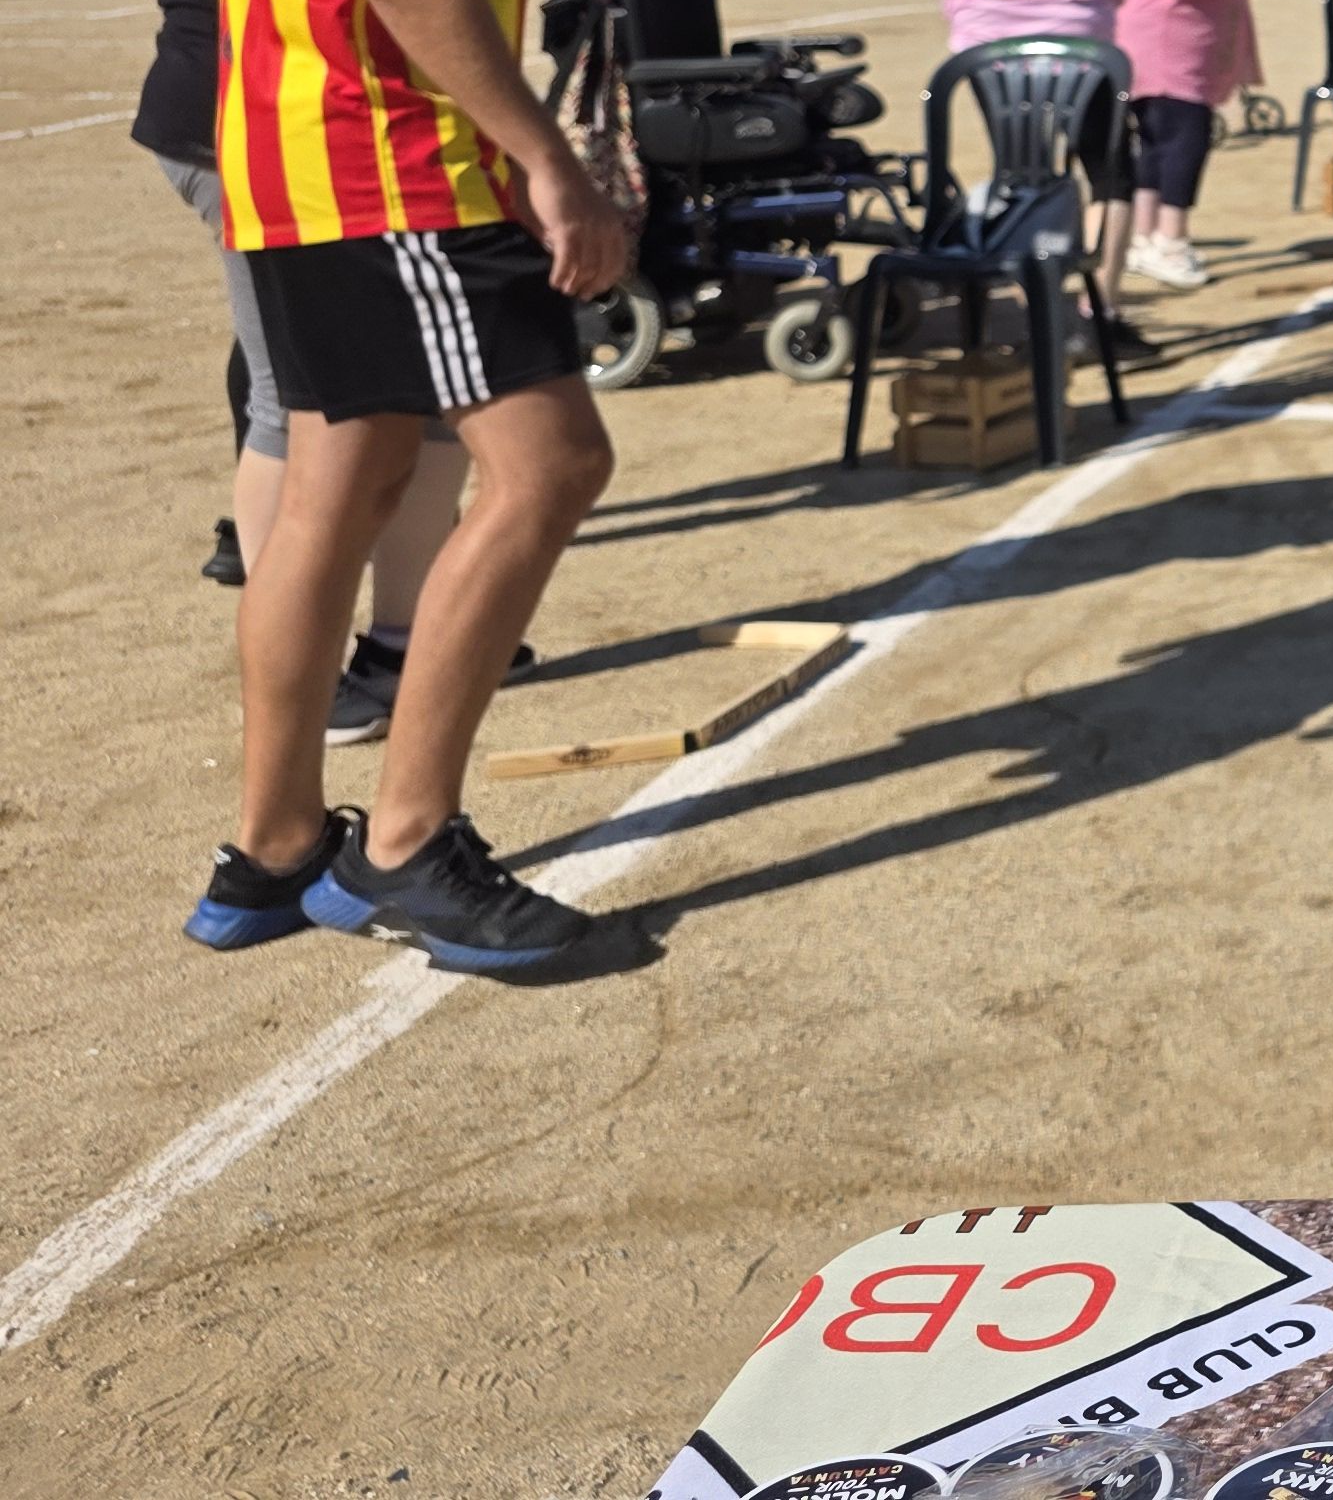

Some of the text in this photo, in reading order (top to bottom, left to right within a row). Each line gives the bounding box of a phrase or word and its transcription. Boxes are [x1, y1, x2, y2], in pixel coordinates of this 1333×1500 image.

[756, 1262, 1117, 1354] CB
[1147, 1320, 1316, 1401] CLUB
[790, 1464, 904, 1486] CATALUNYA
[813, 1477, 869, 1493] TOUR
